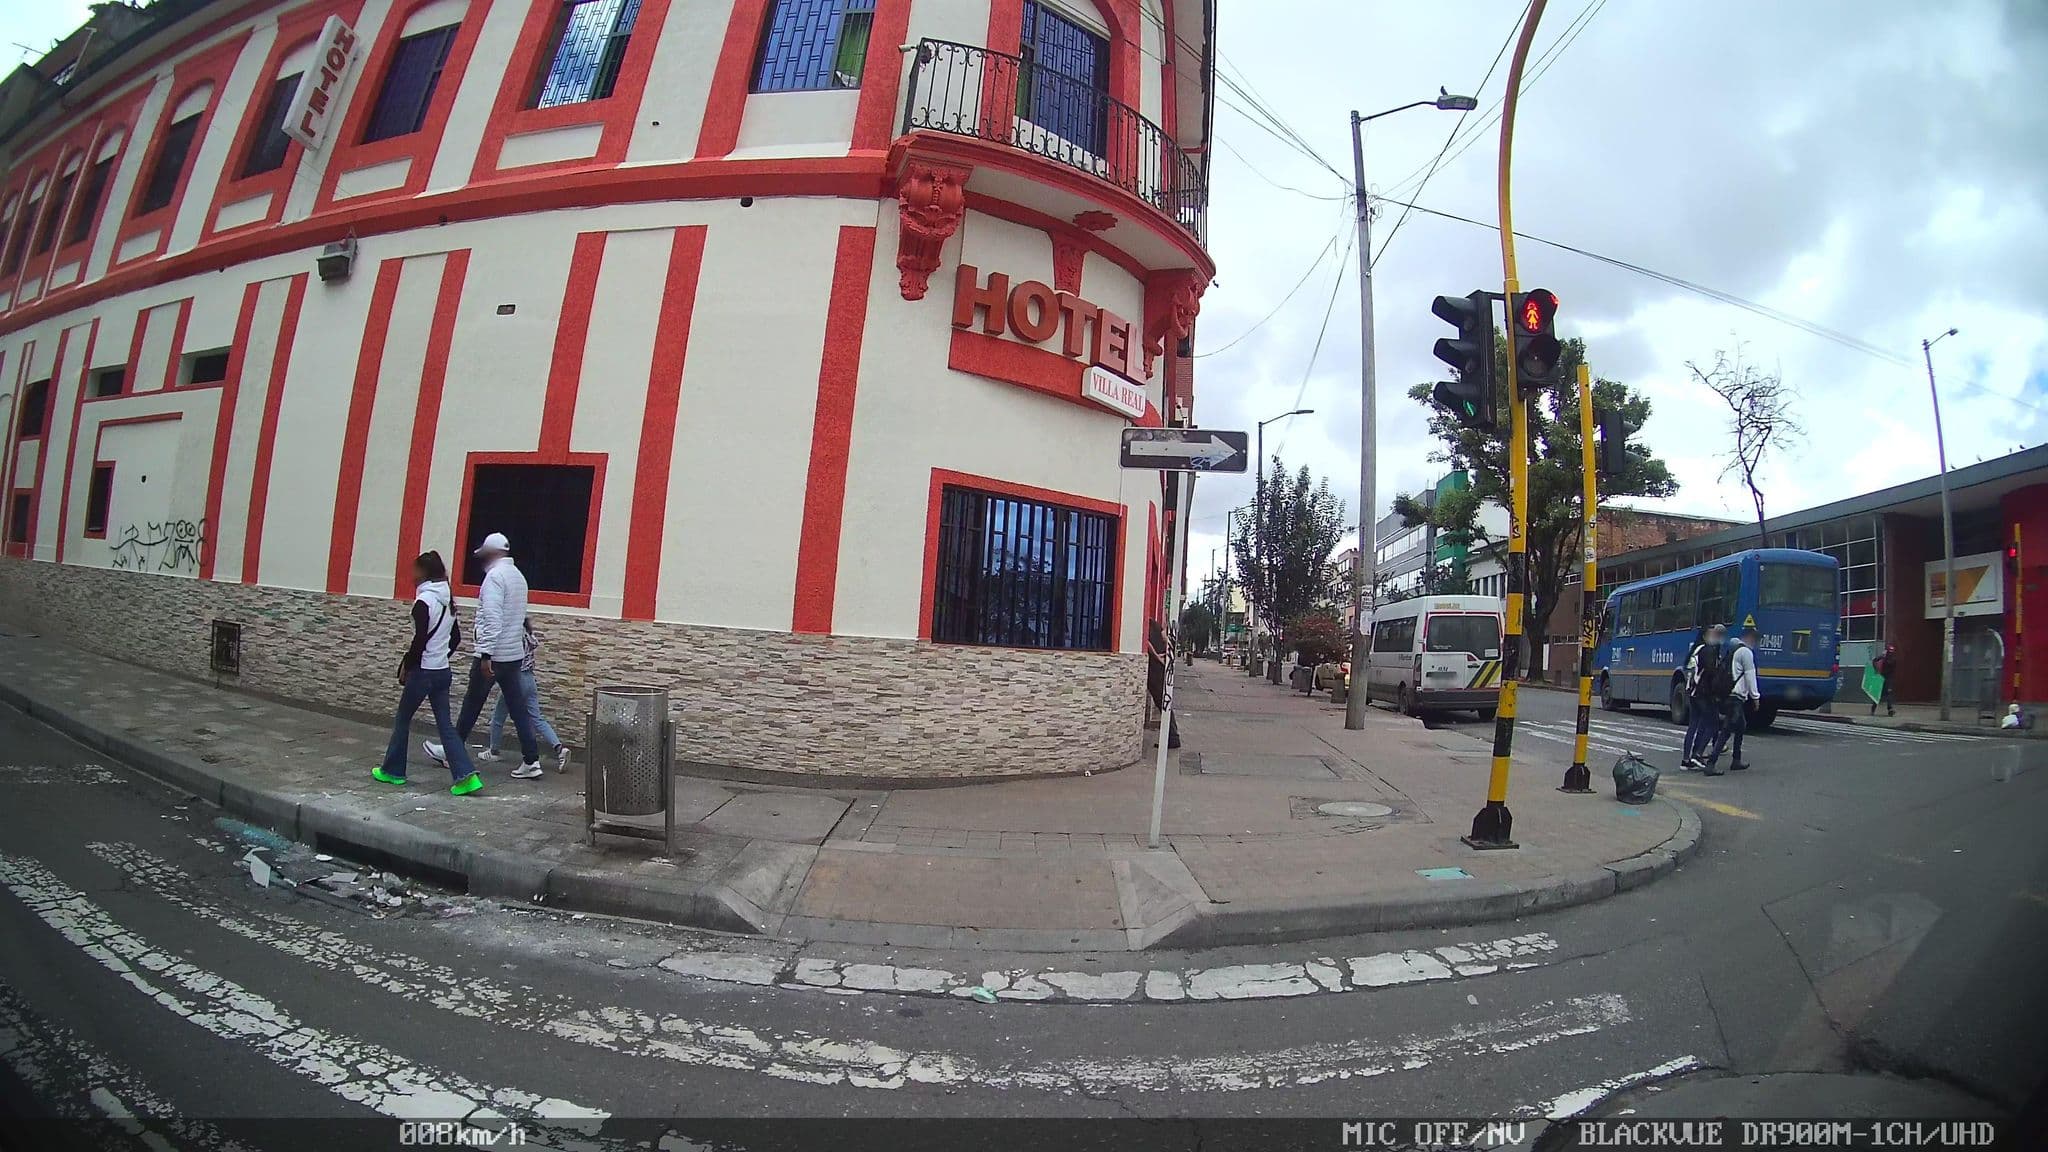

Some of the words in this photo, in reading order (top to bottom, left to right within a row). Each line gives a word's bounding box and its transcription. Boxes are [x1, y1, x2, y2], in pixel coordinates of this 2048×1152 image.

[301, 26, 355, 138] HOTEL
[951, 264, 1147, 386] HOTEL
[1092, 373, 1120, 400] VILLA
[1120, 386, 1145, 413] REAL
[1652, 648, 1674, 663] Urbano
